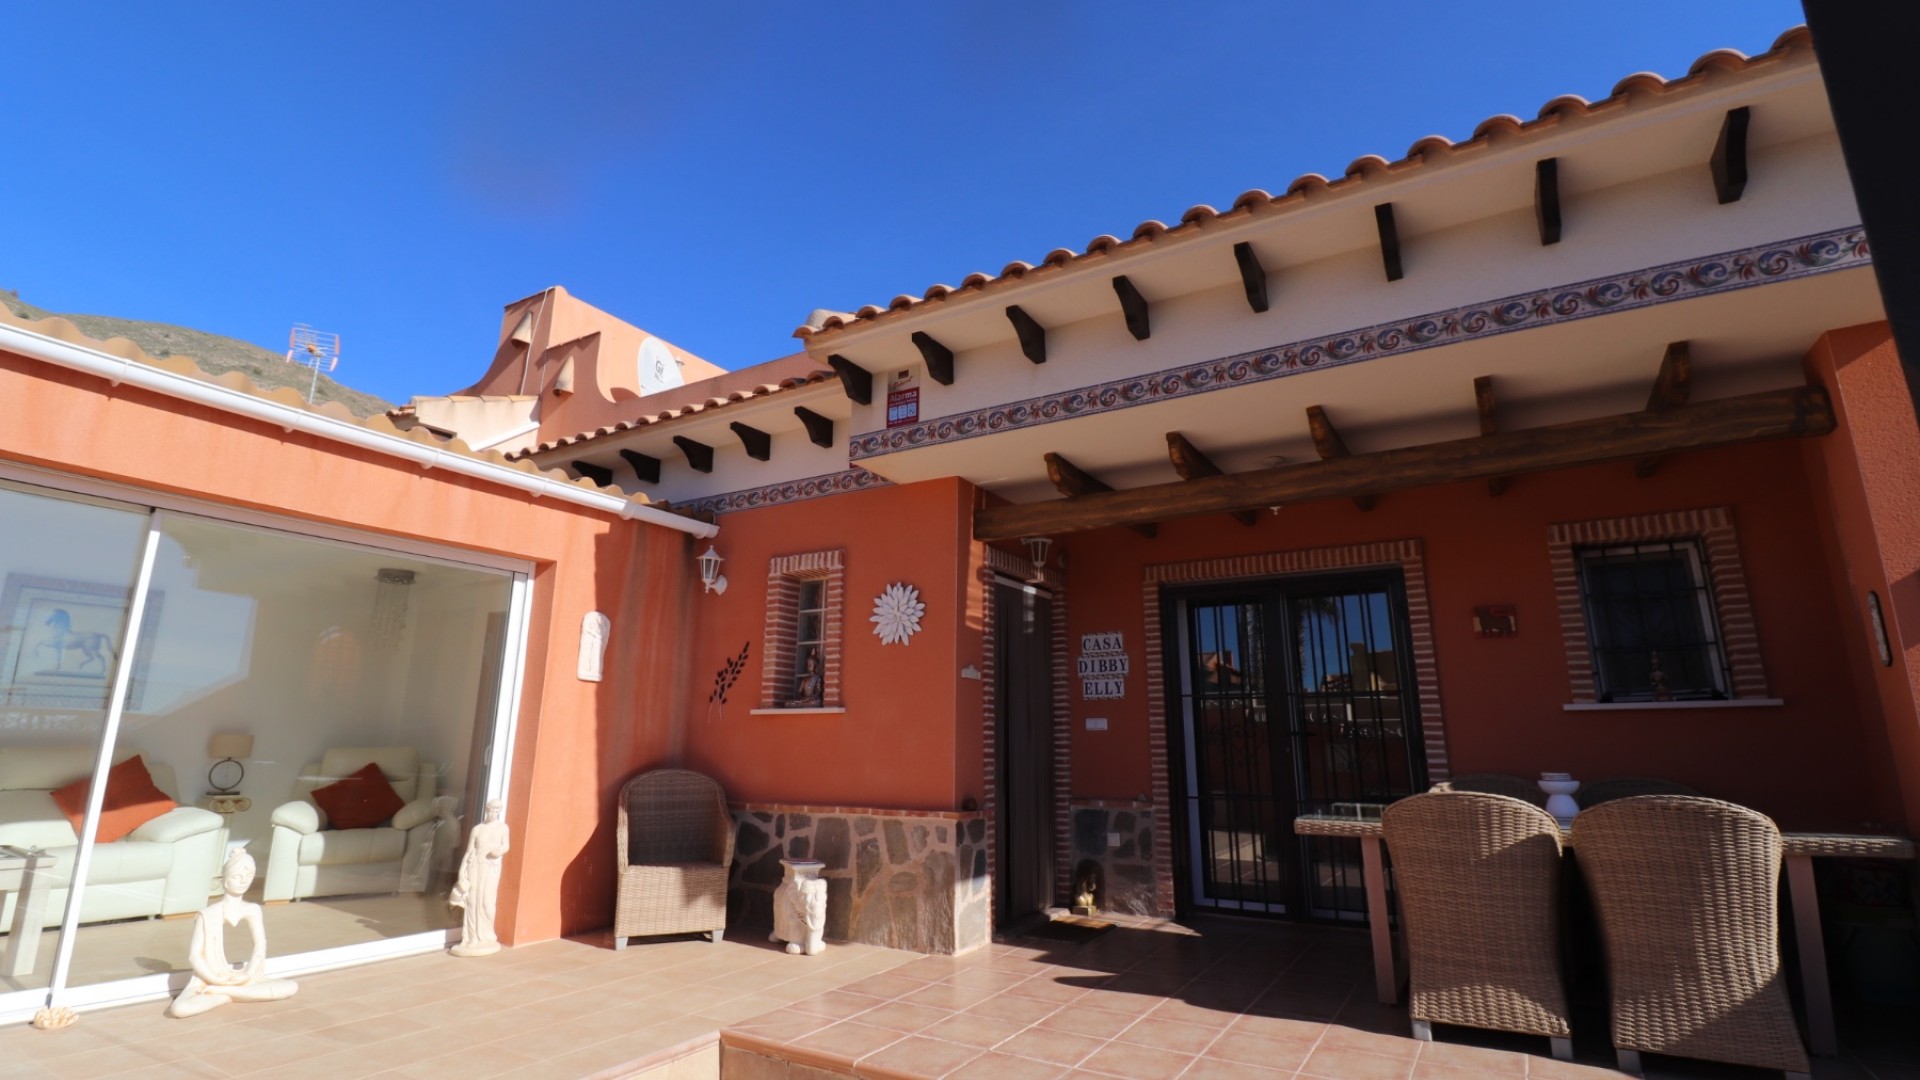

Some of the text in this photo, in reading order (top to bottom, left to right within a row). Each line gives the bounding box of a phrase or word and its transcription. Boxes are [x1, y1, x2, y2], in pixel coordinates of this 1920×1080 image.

[890, 391, 917, 402] Alarma
[1083, 637, 1122, 651] CASA
[1079, 658, 1127, 673] DIBBY
[1084, 681, 1123, 695] ELLY
